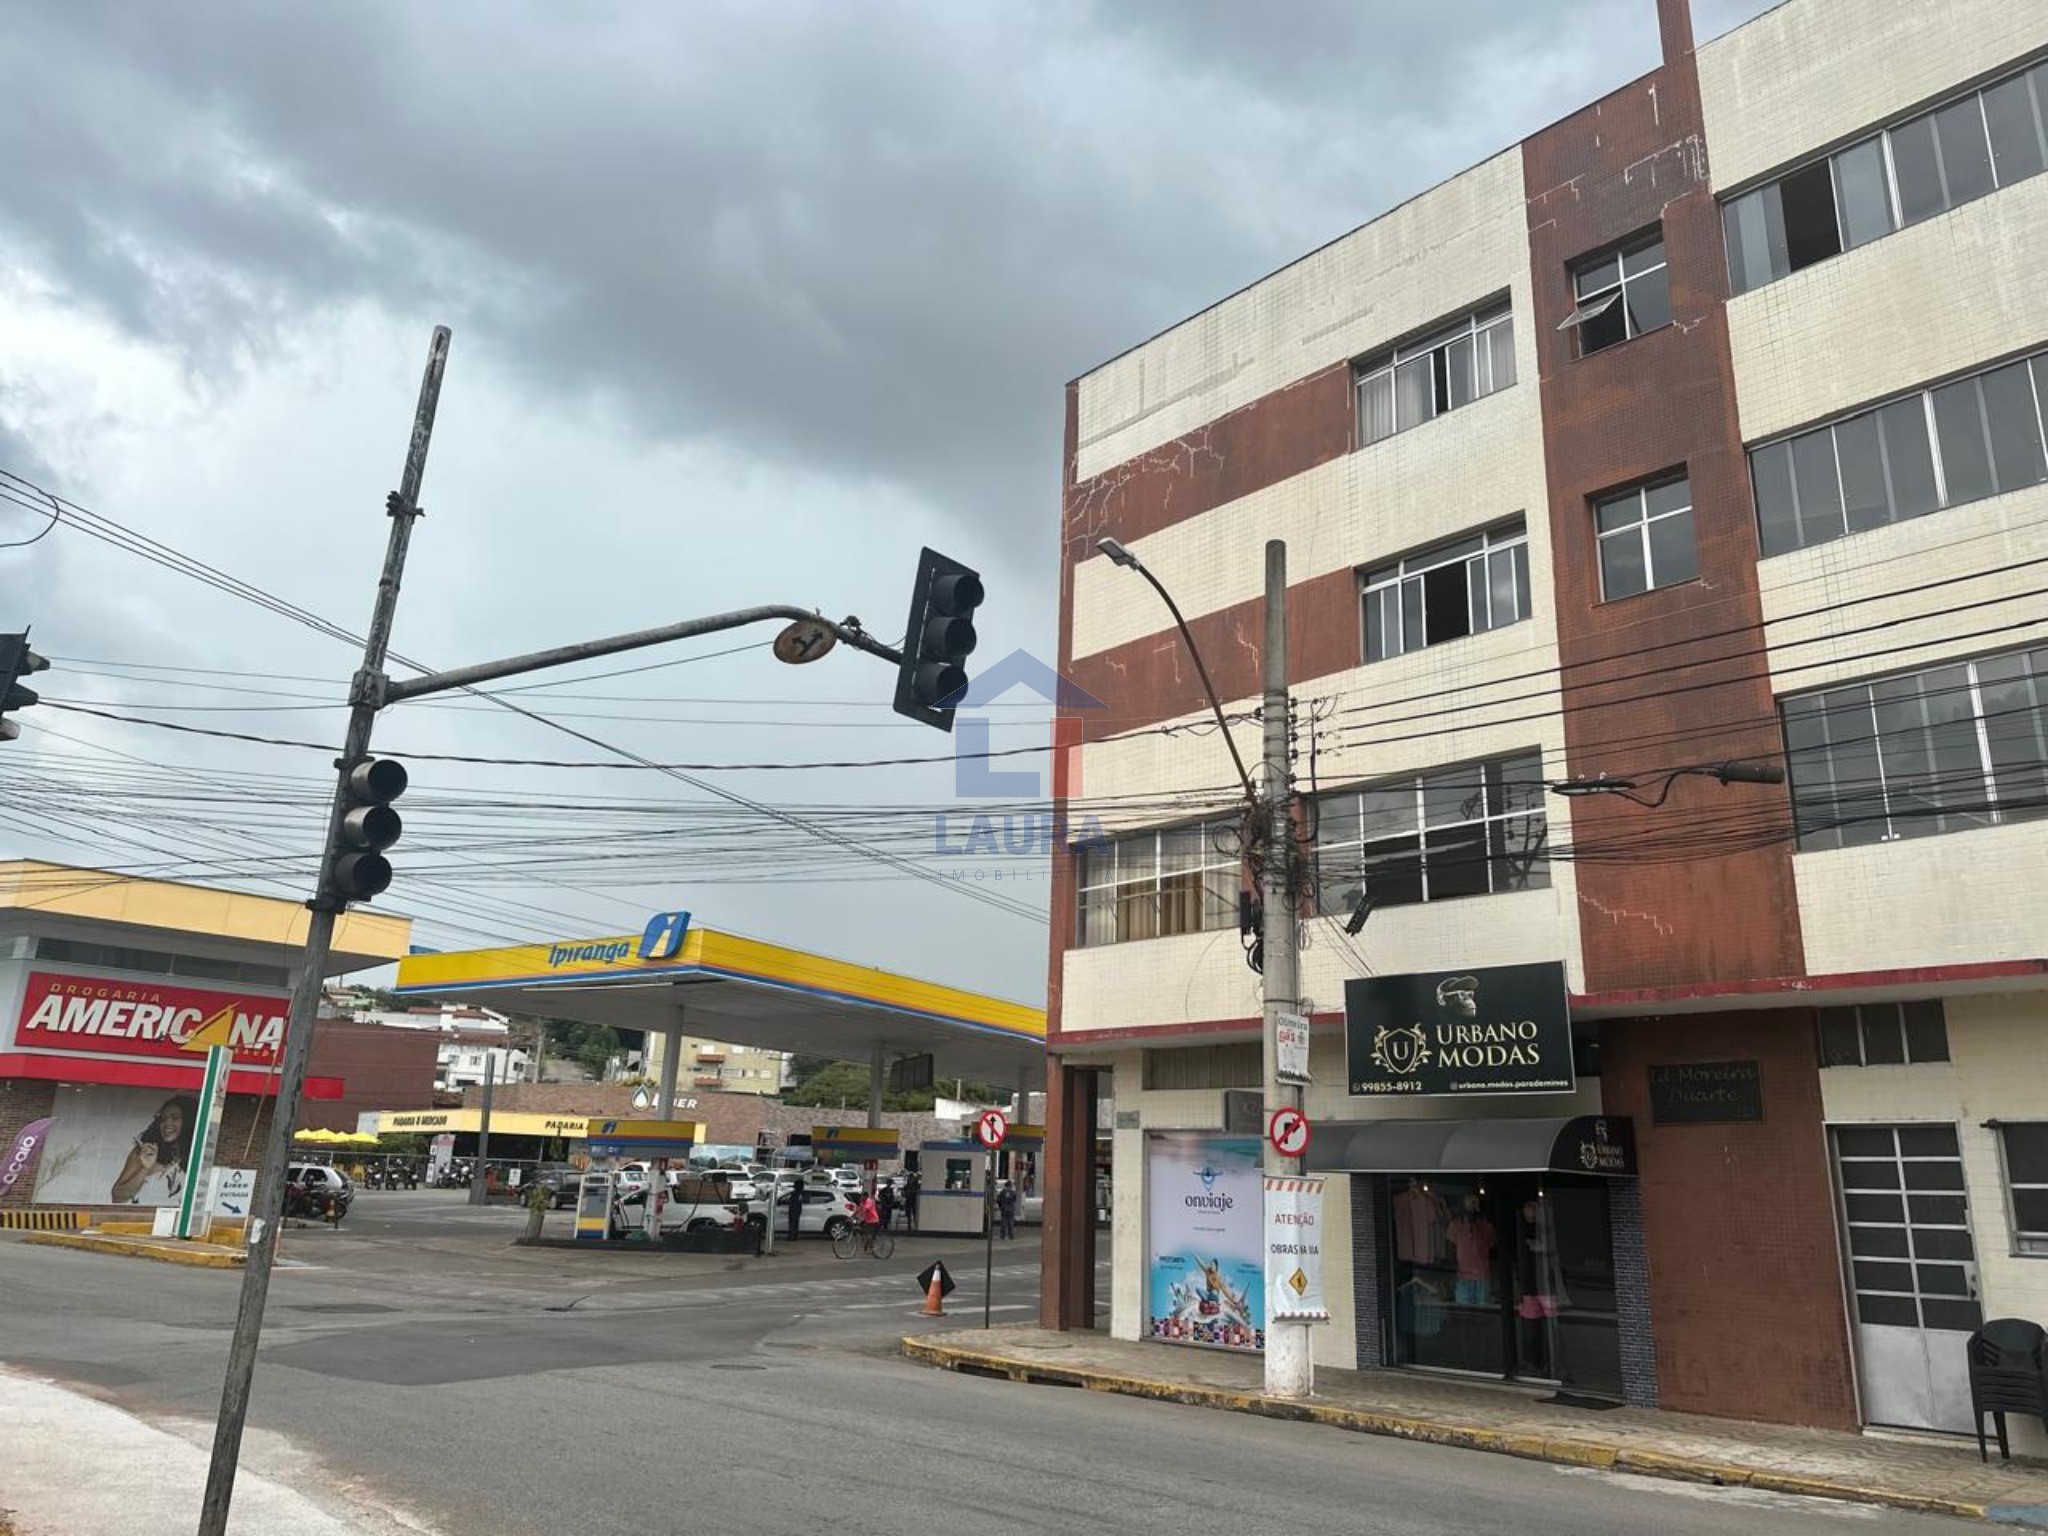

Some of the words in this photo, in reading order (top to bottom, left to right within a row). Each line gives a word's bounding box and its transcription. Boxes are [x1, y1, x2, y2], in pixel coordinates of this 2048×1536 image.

[548, 942, 631, 967] Ipiranga
[50, 982, 160, 1004] DROGARIA
[1436, 1020, 1538, 1045] URBANO
[1437, 1043, 1541, 1068] MODAS
[1361, 1081, 1422, 1092] 99855-8912
[545, 1120, 584, 1130] PADARIA
[1185, 1193, 1233, 1211] onviaje
[1274, 1211, 1315, 1228] ATENÇÃO
[1270, 1244, 1299, 1255] OBRAS
